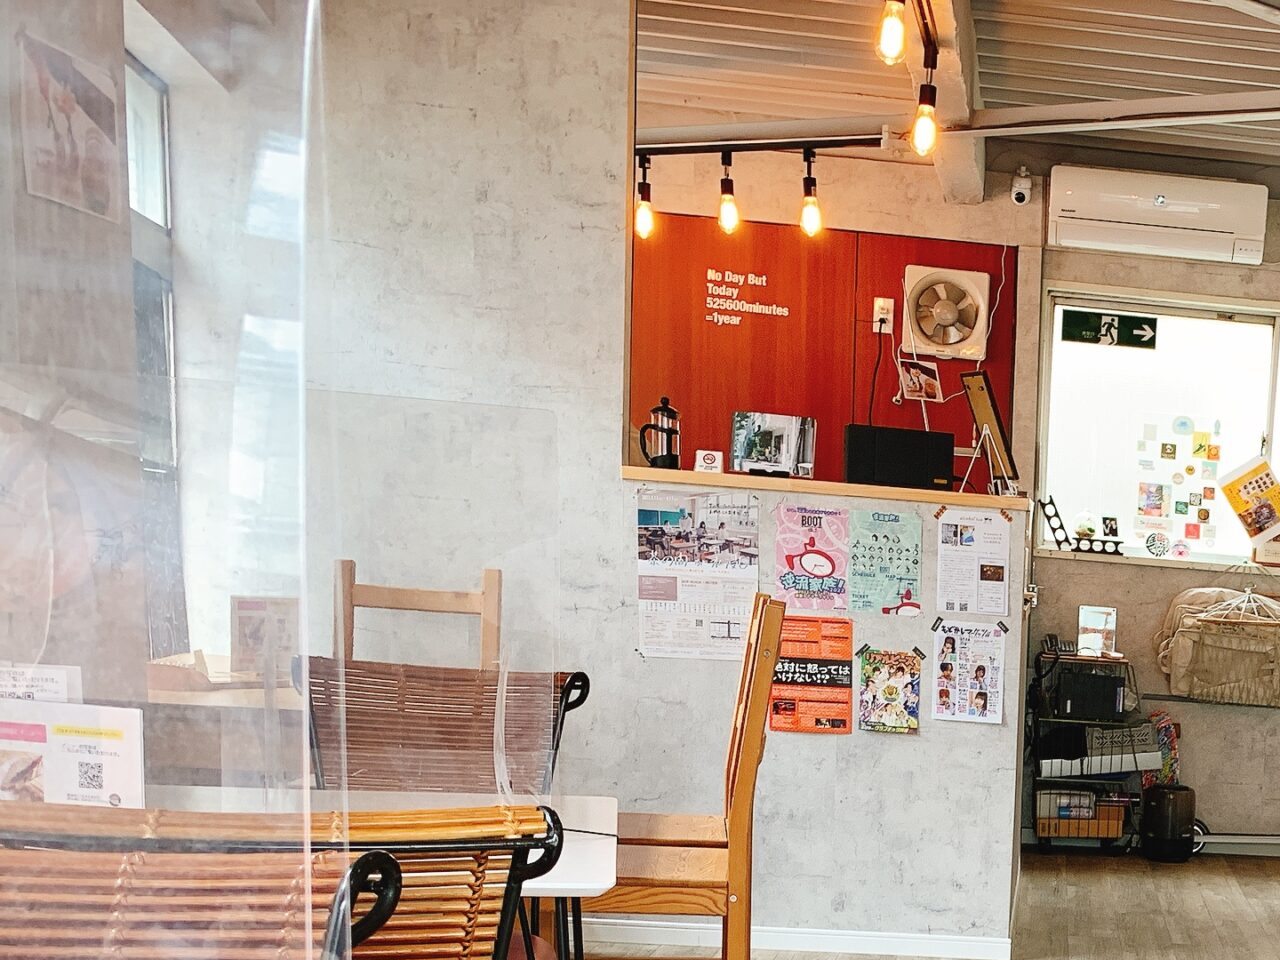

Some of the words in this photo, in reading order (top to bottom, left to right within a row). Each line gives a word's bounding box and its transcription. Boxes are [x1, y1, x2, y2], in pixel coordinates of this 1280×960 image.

[707, 268, 722, 281] No
[724, 271, 745, 286] Day
[747, 273, 767, 286] But
[706, 283, 739, 299] Today
[705, 297, 790, 317] 525600minutes
[801, 515, 823, 528] BOOT
